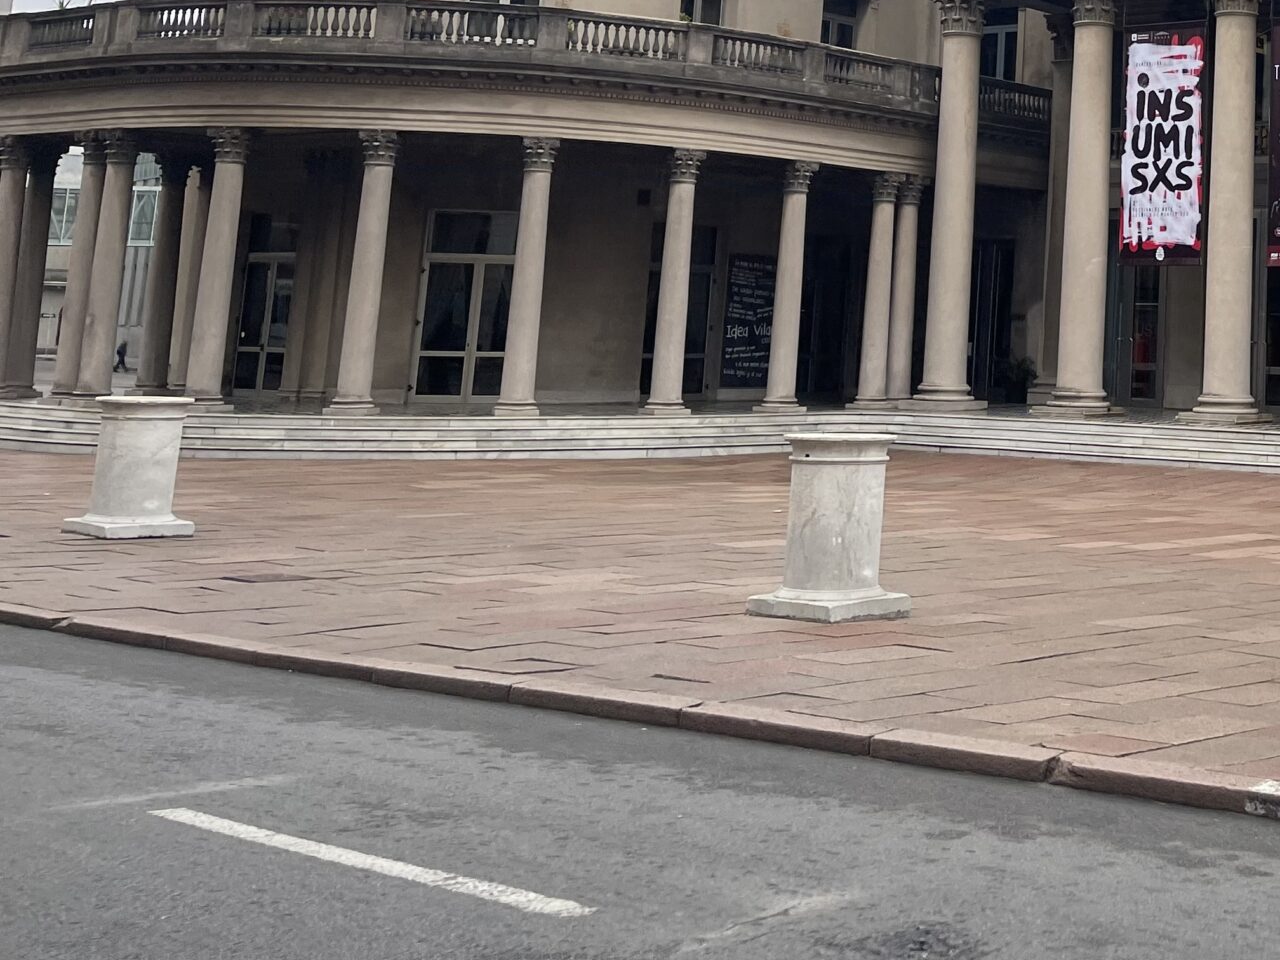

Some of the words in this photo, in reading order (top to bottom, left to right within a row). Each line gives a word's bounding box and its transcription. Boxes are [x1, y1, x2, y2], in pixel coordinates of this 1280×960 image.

[1132, 123, 1194, 161] UMI
[1130, 158, 1194, 195] SXS
[726, 324, 749, 340] Idea
